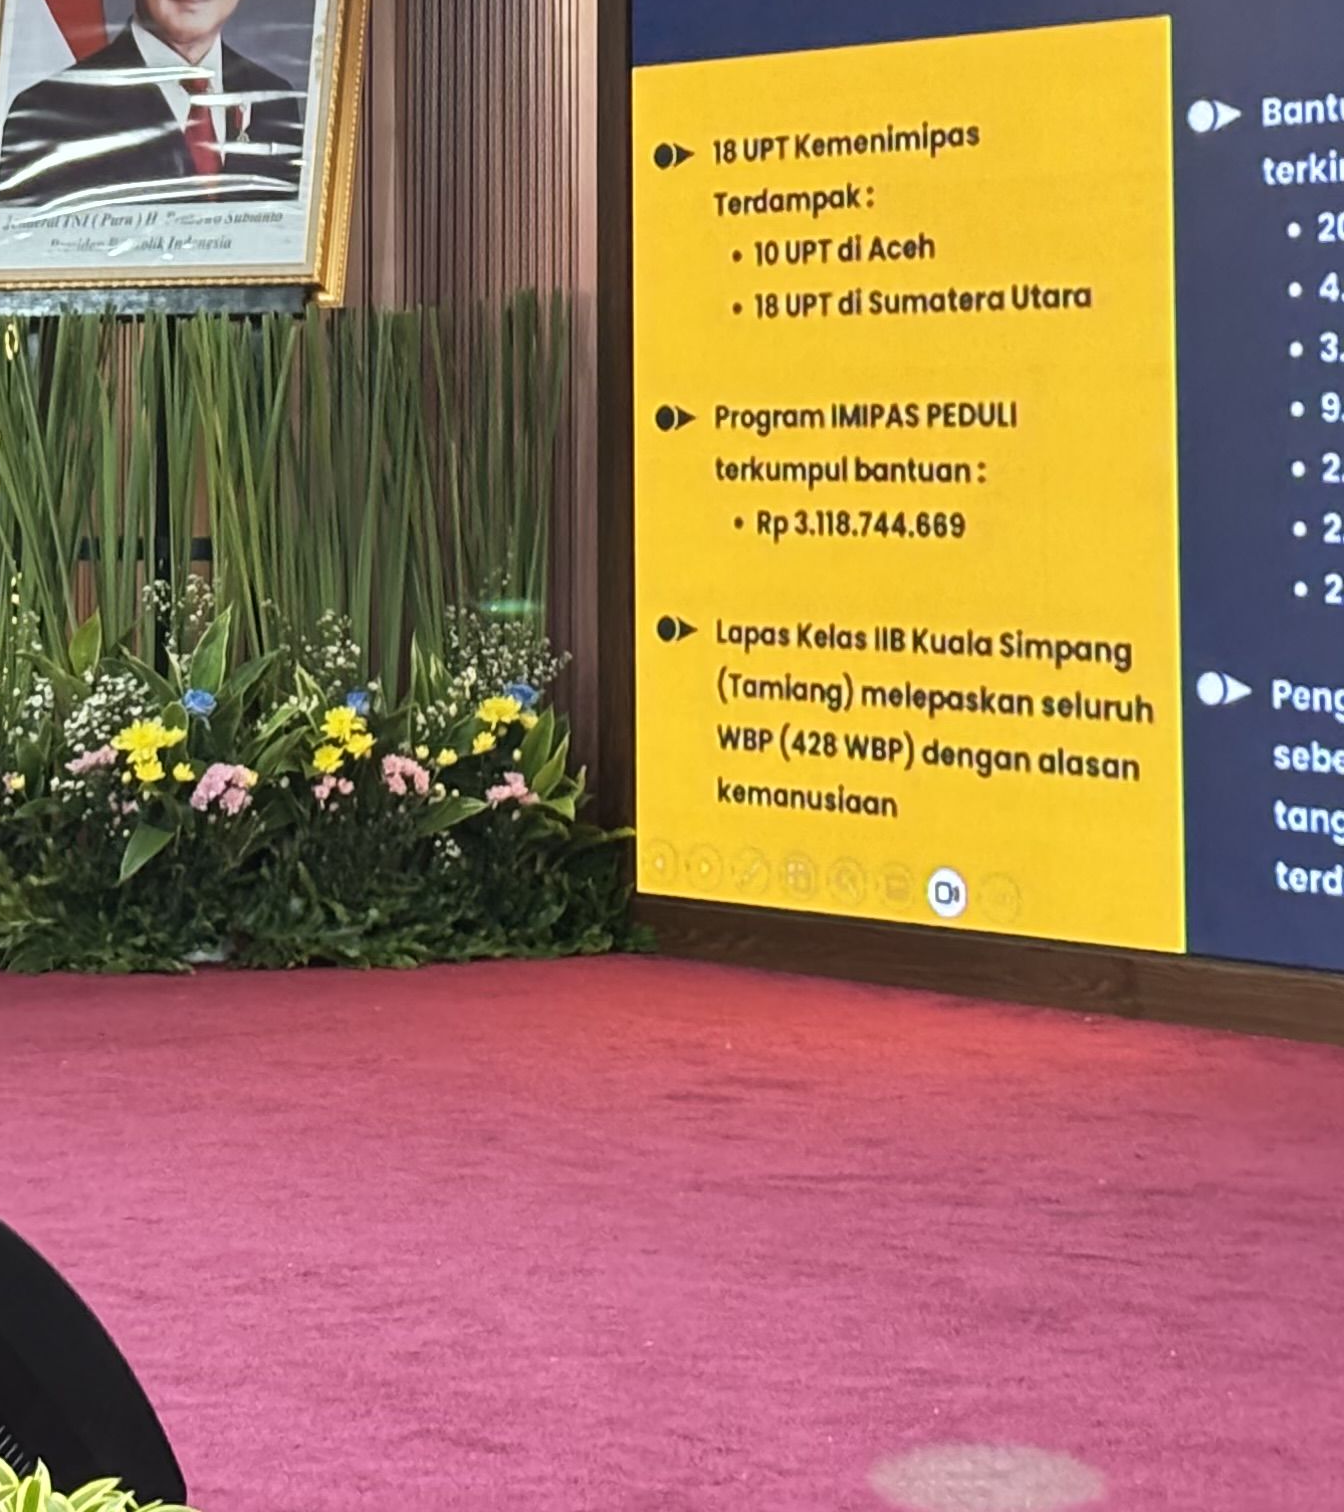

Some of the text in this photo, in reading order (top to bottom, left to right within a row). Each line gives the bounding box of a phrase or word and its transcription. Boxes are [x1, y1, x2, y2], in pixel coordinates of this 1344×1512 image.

[714, 122, 979, 164] 18 UPT Kemenimipas
[714, 183, 860, 219] Terdampak
[62, 214, 89, 229] TNI
[755, 233, 935, 266] 10 UPT di Aceh
[755, 285, 1091, 318] 18 UPT di Sumatera Utara
[716, 402, 1016, 437] Program IMIPAS PEDULI
[716, 456, 847, 490] terkumpul
[855, 457, 970, 483] bantuan
[757, 510, 788, 543] Rp
[717, 620, 1132, 673] Lapas Kelas IIB Kuala Simpang
[718, 666, 1153, 723] (Tamiang) melepaskan seluruh
[718, 723, 1139, 781] WBP (428 WBP) dengan alasan
[718, 777, 897, 817] kemanusiaan
